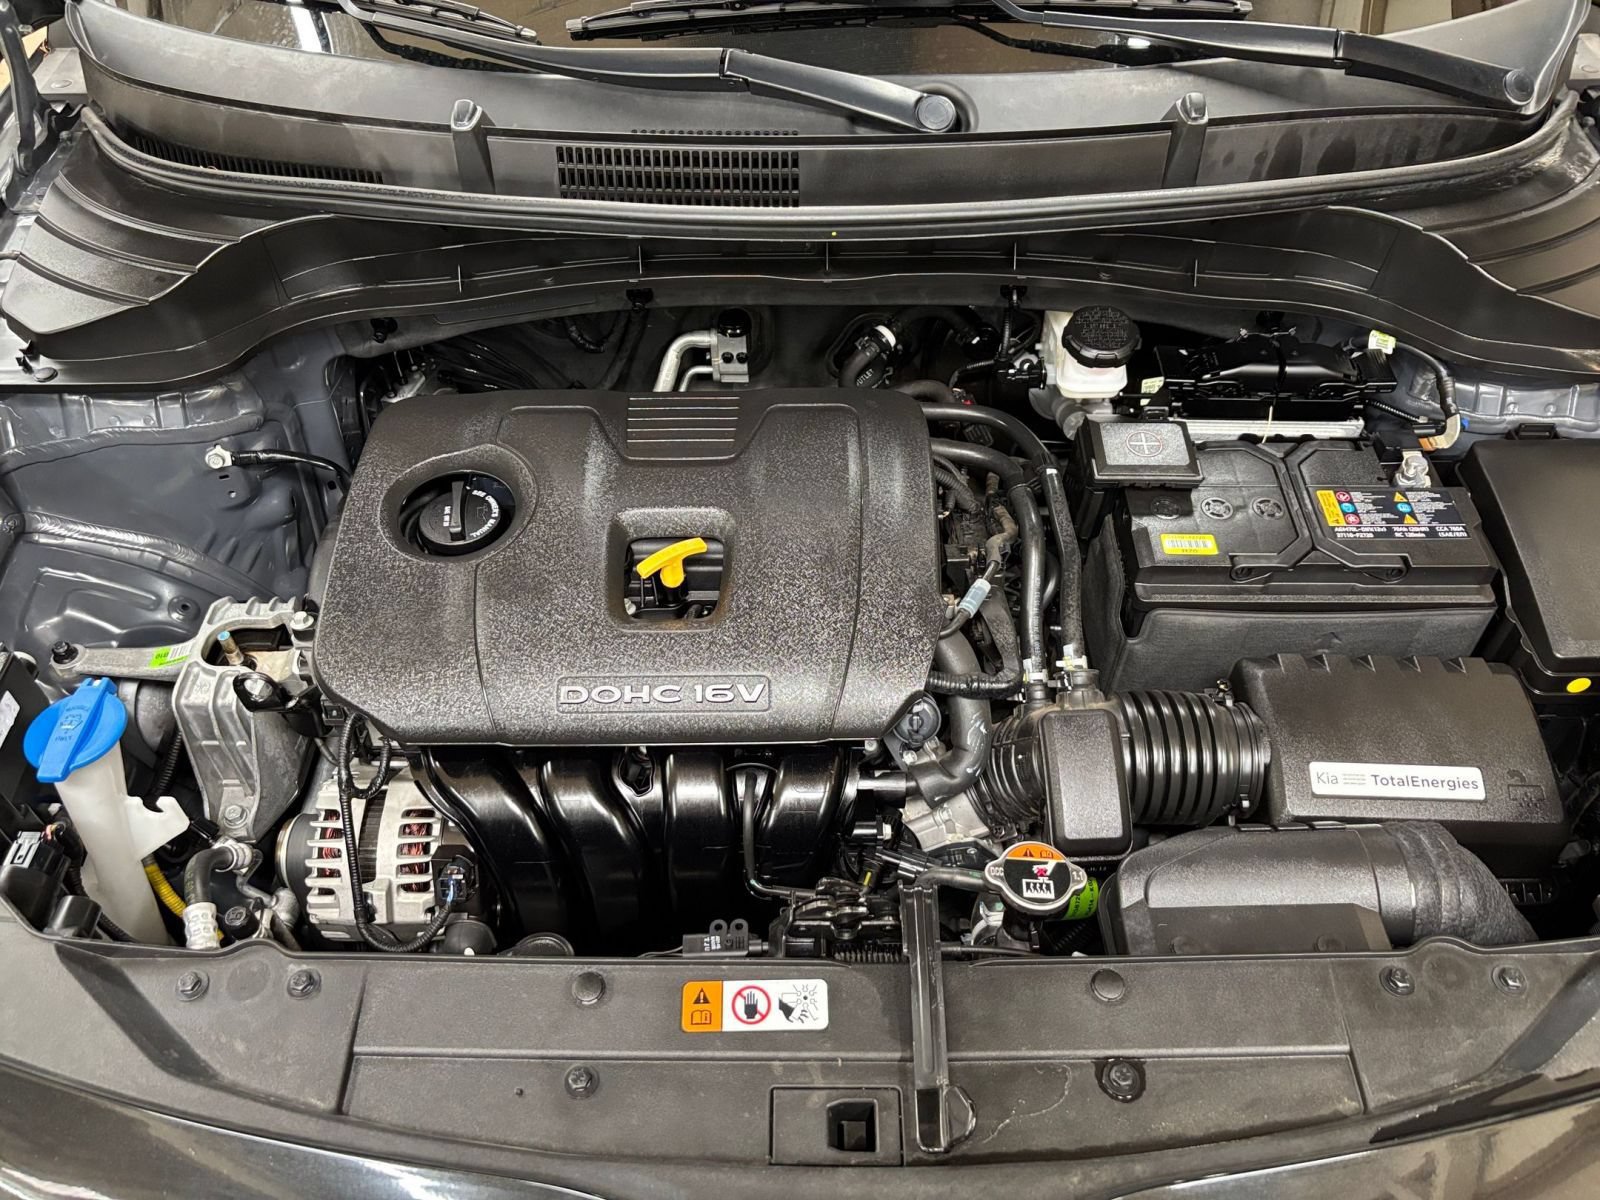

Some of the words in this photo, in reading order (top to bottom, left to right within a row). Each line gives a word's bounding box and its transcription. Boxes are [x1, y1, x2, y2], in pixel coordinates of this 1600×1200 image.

[470, 519, 496, 537] MANUAL
[560, 685, 682, 704] DOHC
[695, 684, 765, 703] 16V
[1316, 772, 1339, 785] Kia
[1371, 774, 1479, 791] TotalEnergies
